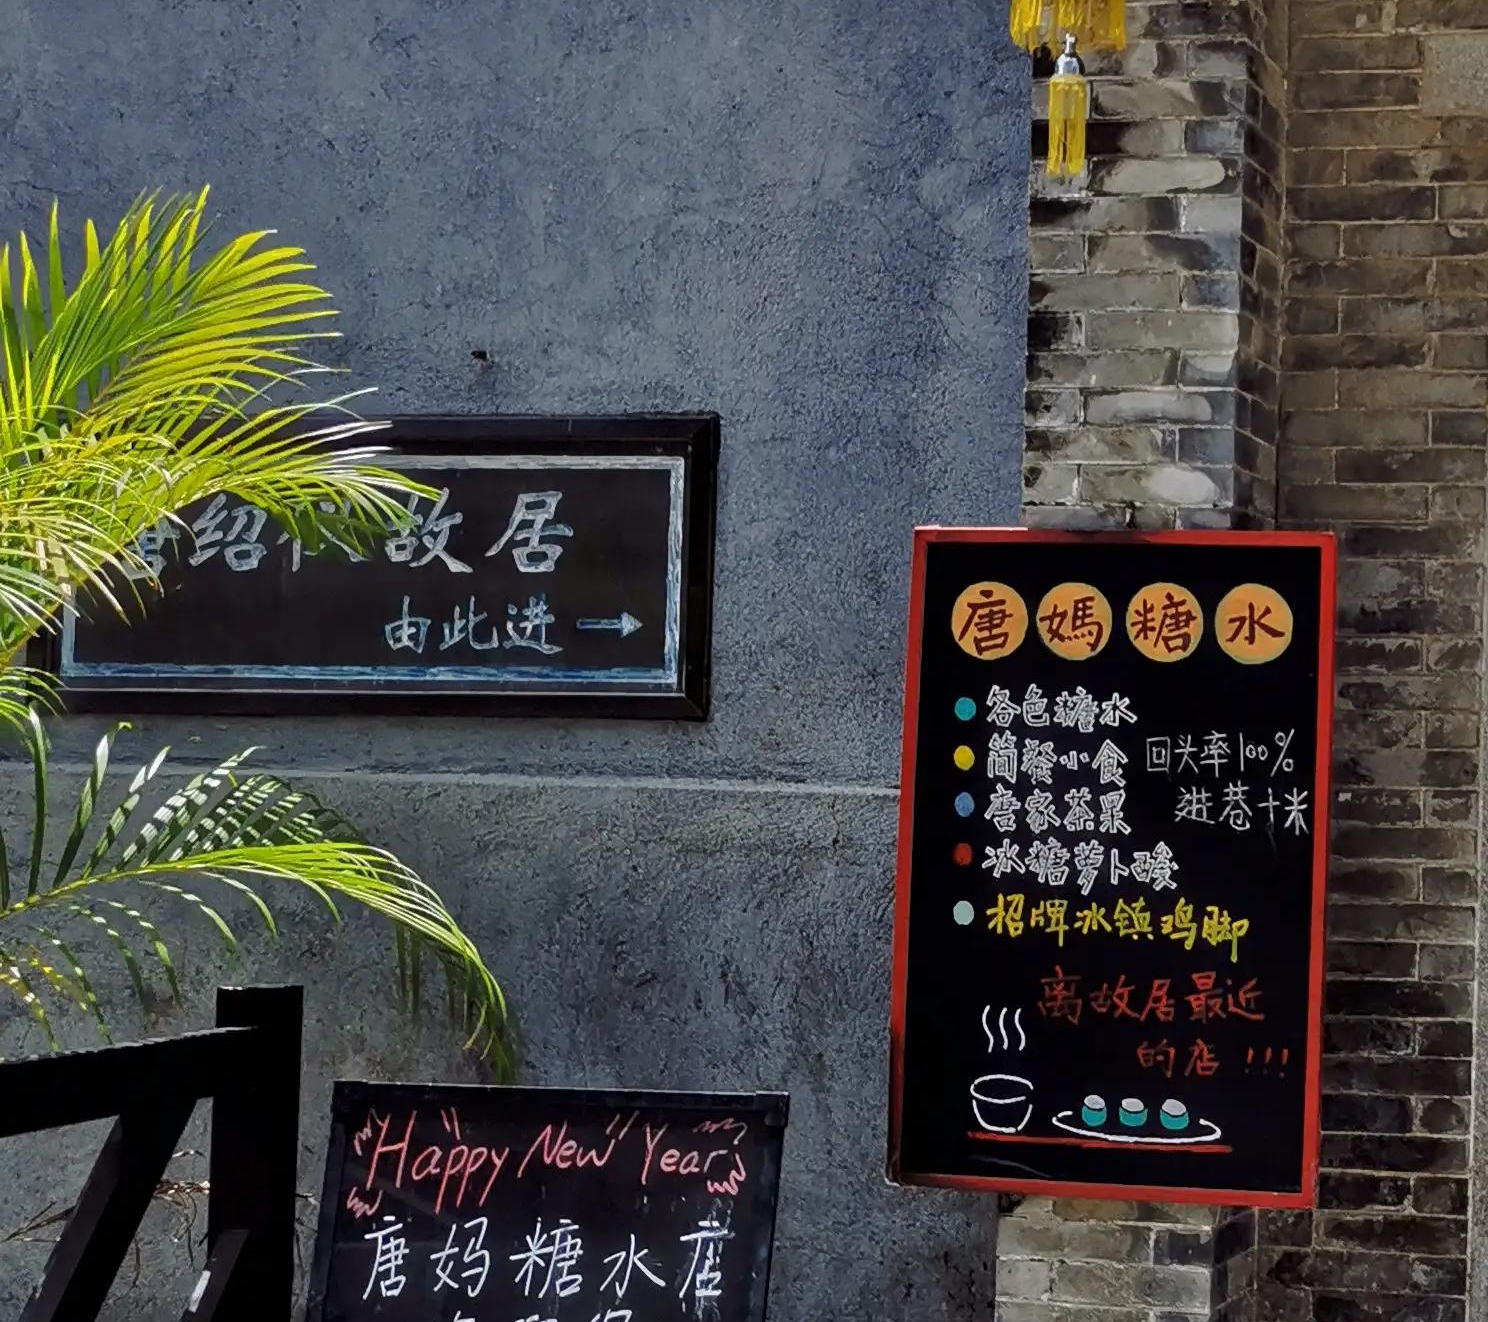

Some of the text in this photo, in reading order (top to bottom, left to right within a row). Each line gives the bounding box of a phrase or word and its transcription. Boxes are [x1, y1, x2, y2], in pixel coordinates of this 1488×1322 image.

[384, 593, 564, 655] 由此进
[957, 589, 1286, 655] 唐媽糖水
[985, 683, 1139, 734] 各色糖水
[987, 729, 1129, 788] 简餐小食
[983, 782, 1132, 836] 唐家茶果
[1173, 780, 1310, 837] 进巷十米
[981, 836, 1180, 896] 冰糖萝卜酸
[1036, 964, 1265, 1027] 离故居最近
[366, 1109, 728, 1214] Happy New Year
[362, 1216, 735, 1301] 唐妈糖水店
